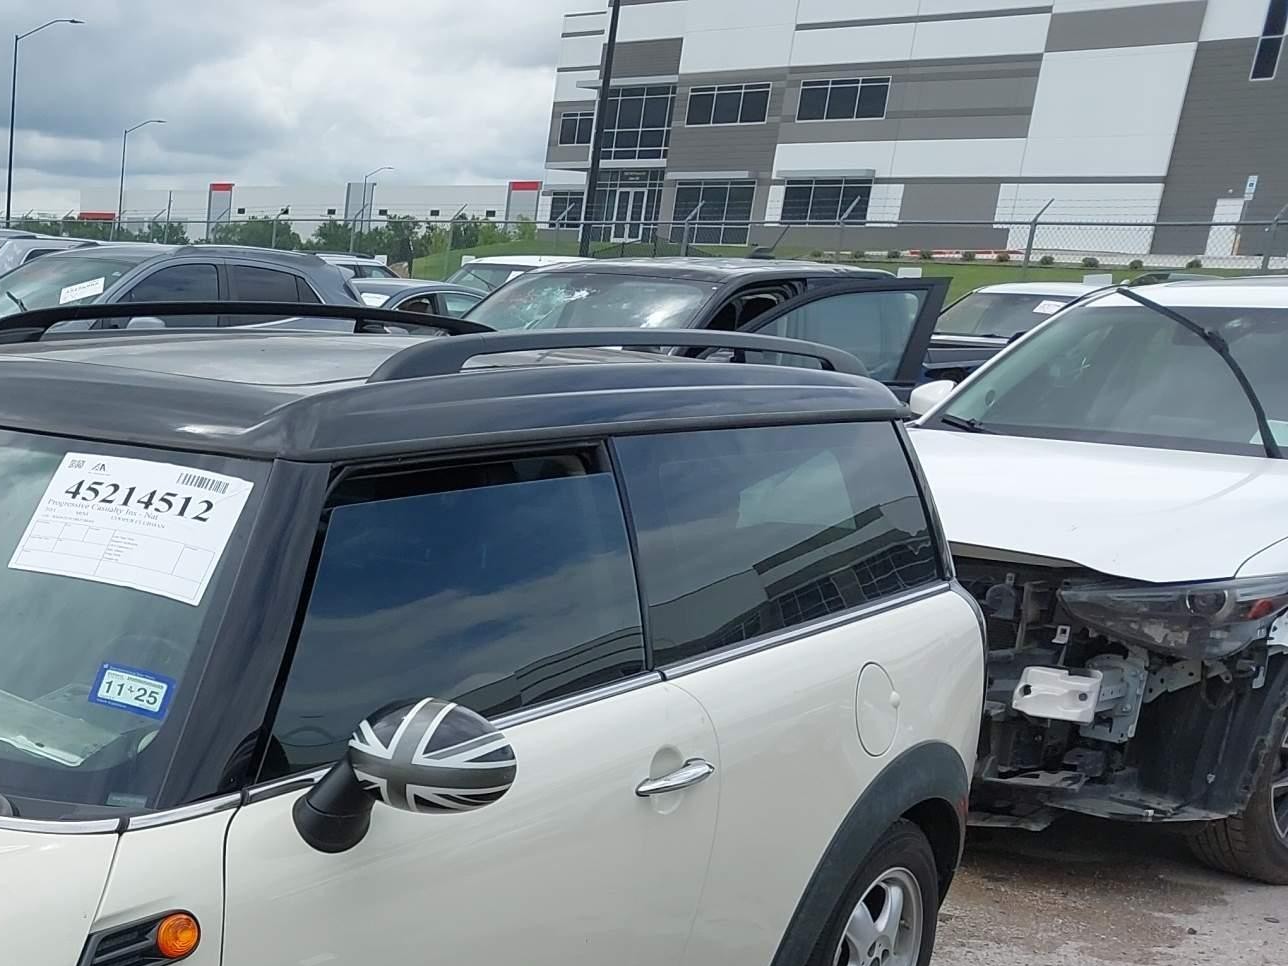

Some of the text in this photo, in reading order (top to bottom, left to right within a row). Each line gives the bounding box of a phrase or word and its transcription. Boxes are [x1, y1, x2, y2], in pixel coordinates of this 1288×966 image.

[47, 498, 90, 511] Progressive
[91, 503, 123, 515] Casualty
[65, 479, 214, 522] 45214512
[133, 688, 158, 705] 25
